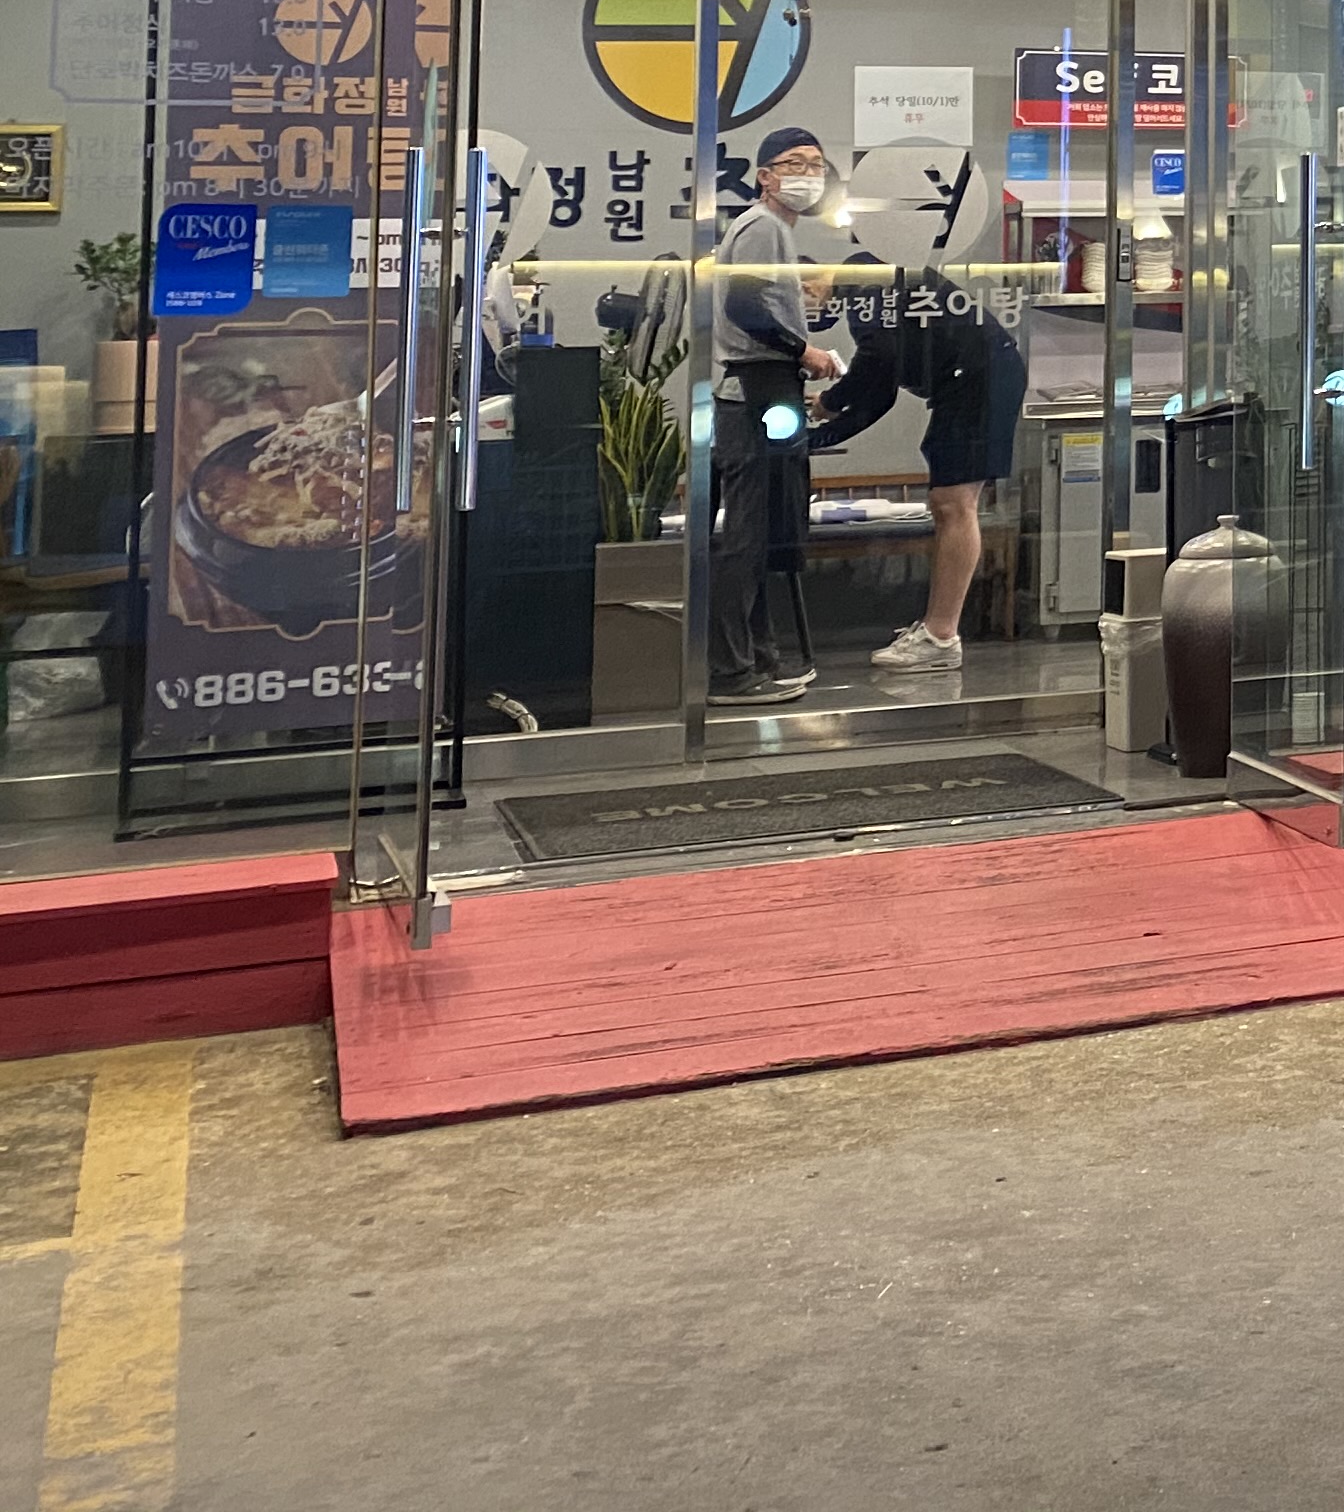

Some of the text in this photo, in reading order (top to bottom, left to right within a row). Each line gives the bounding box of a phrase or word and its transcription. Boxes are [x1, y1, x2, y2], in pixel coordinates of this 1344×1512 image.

[231, 76, 377, 116] 금화정
[603, 149, 651, 243] 남원
[168, 214, 248, 239] CESCO
[903, 284, 1030, 329] 추어탕
